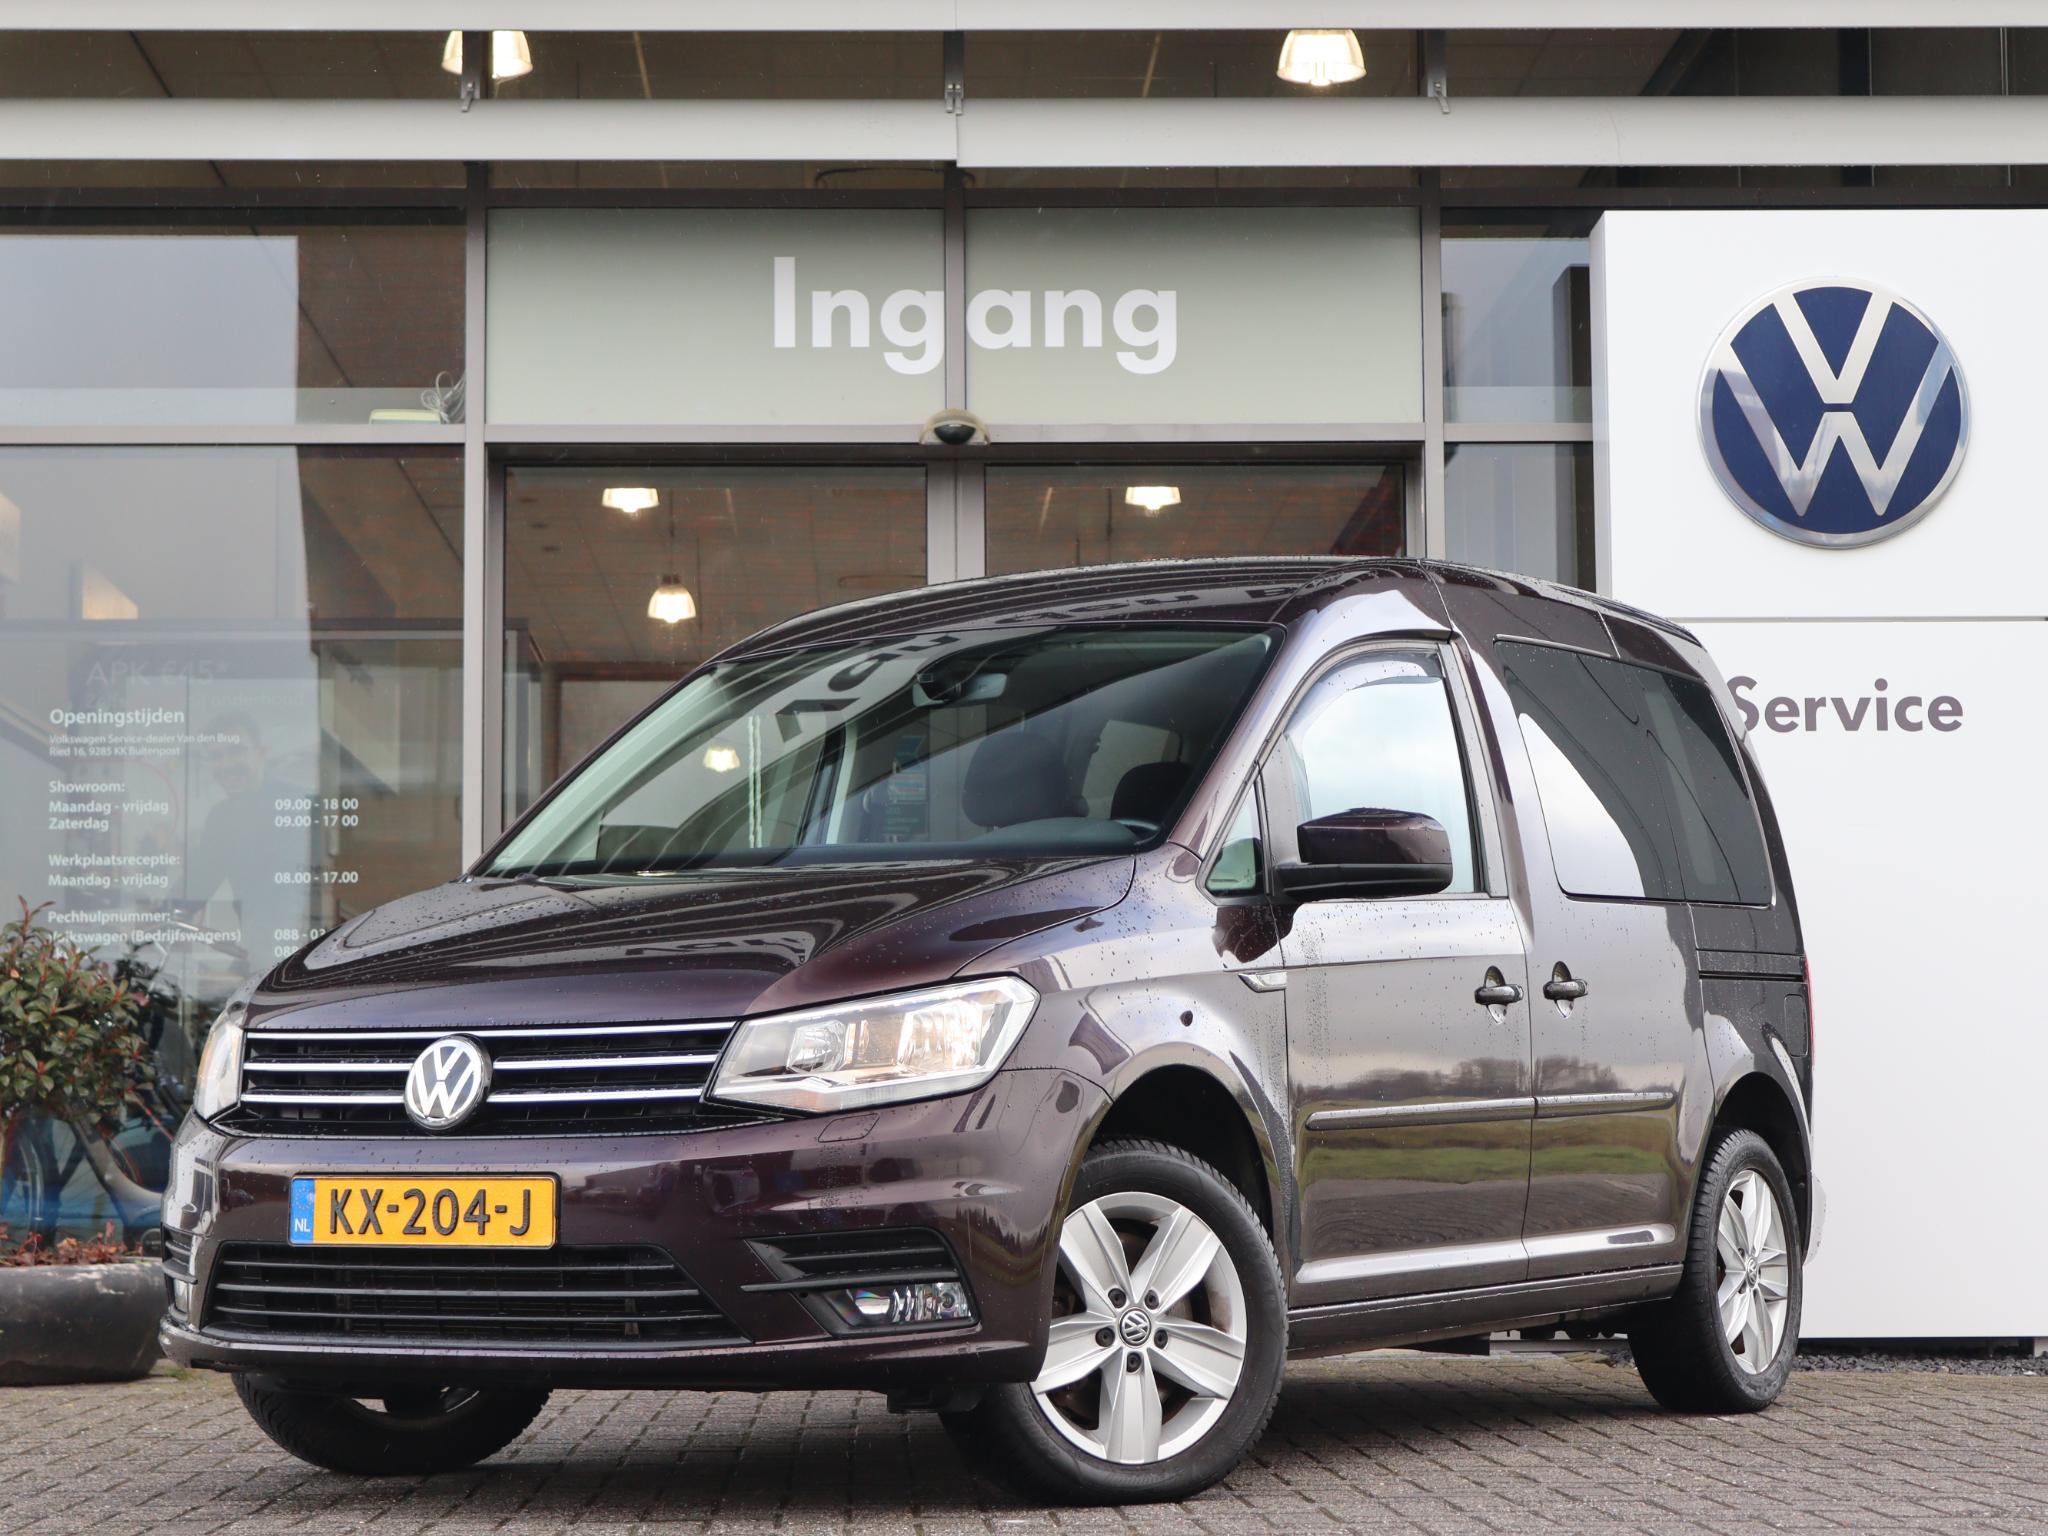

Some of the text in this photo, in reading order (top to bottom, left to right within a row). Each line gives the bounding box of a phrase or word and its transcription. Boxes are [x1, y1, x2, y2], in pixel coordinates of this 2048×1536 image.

[773, 256, 1178, 375] Ingang
[1726, 674, 1964, 733] Service
[50, 708, 185, 728] Openingstijden
[50, 735, 106, 745] Volkswagen
[177, 734, 195, 743] Van
[197, 733, 216, 743] den
[217, 733, 240, 744] Brug
[49, 780, 125, 793] Showroom:
[49, 800, 112, 815] Maandag
[122, 800, 169, 815] vrijdag
[275, 799, 312, 810] 09.00
[49, 817, 109, 832] Zaterdag
[275, 815, 312, 827] 09.00
[49, 853, 181, 868] Werkplaatsreceptie:
[49, 874, 112, 889] Maandag
[122, 874, 168, 889] vrijdag
[274, 872, 311, 884] 08.00
[323, 872, 359, 883] 17.00
[48, 910, 171, 925] Pechhulpnummer:
[131, 930, 241, 946] (Bedrijfswagens)
[274, 928, 299, 940] 088
[329, 1188, 531, 1236] KX-204-J
[294, 1218, 311, 1233] NL
